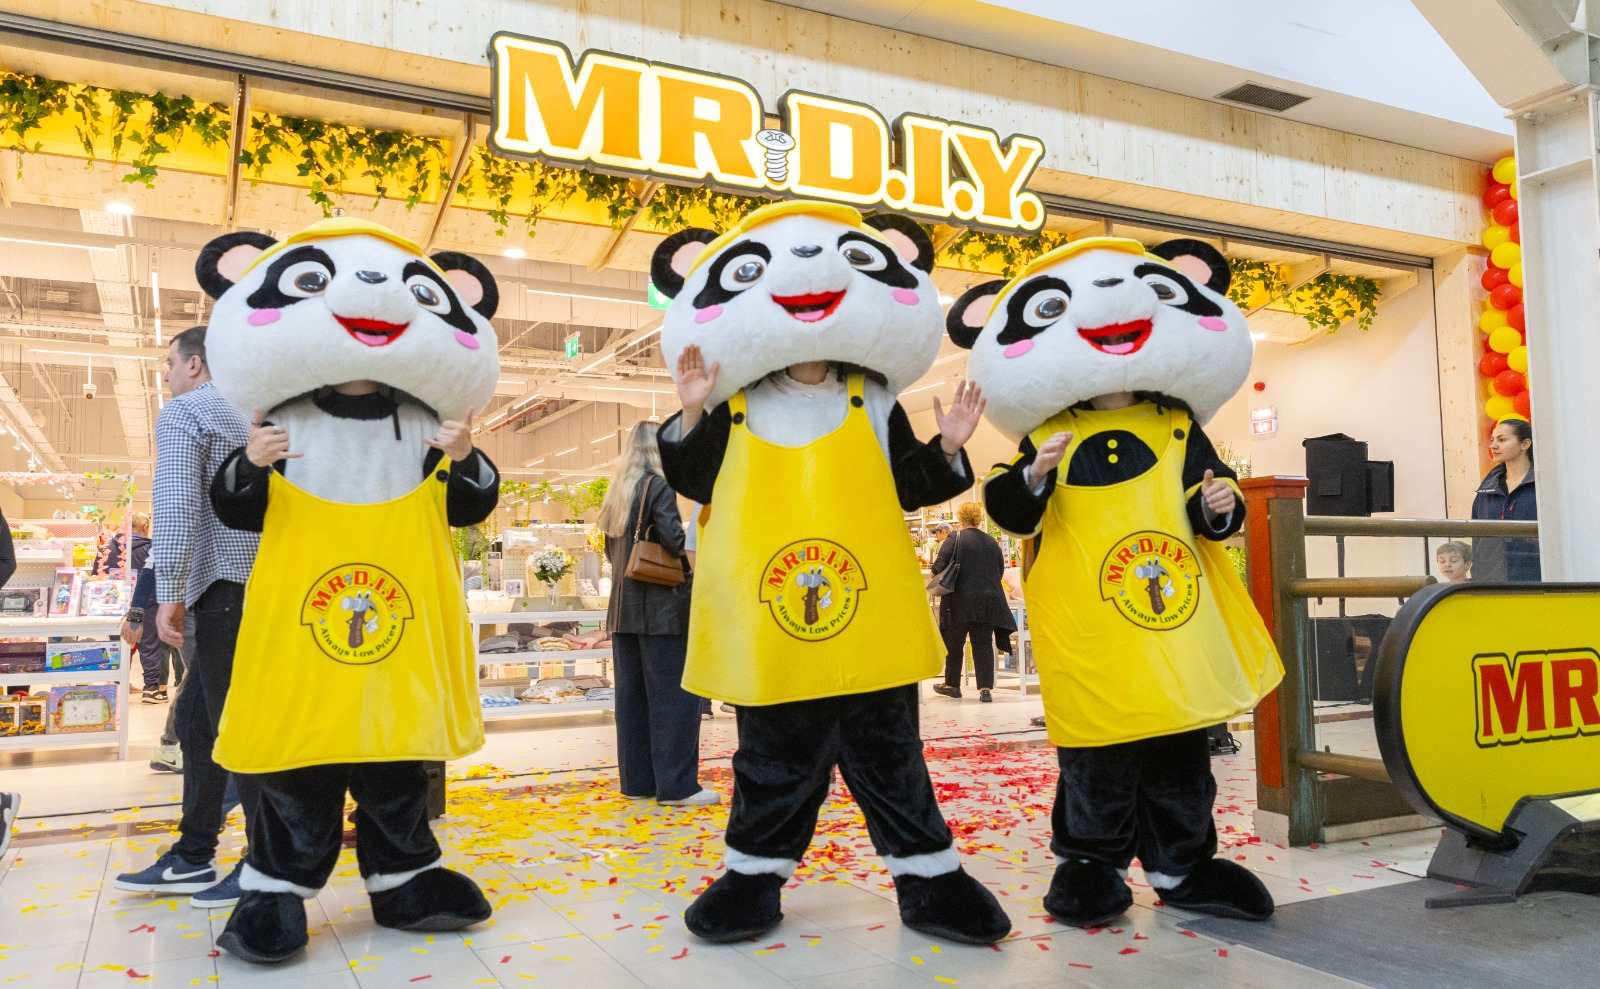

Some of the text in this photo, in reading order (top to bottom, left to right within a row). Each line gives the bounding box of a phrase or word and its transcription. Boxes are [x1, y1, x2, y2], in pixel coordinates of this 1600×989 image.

[503, 42, 1039, 221] MR D.I.Y.
[768, 546, 854, 588] MR D.I.Y.
[1106, 538, 1189, 584] MR D.I.Y.
[311, 570, 400, 611] MR D.I.Y.
[1123, 599, 1157, 623] Always
[1177, 583, 1192, 615] Prices
[778, 597, 851, 634] Always Low Prices
[321, 627, 350, 656] Always
[375, 624, 397, 652] Prices
[1478, 657, 1600, 738] MR
